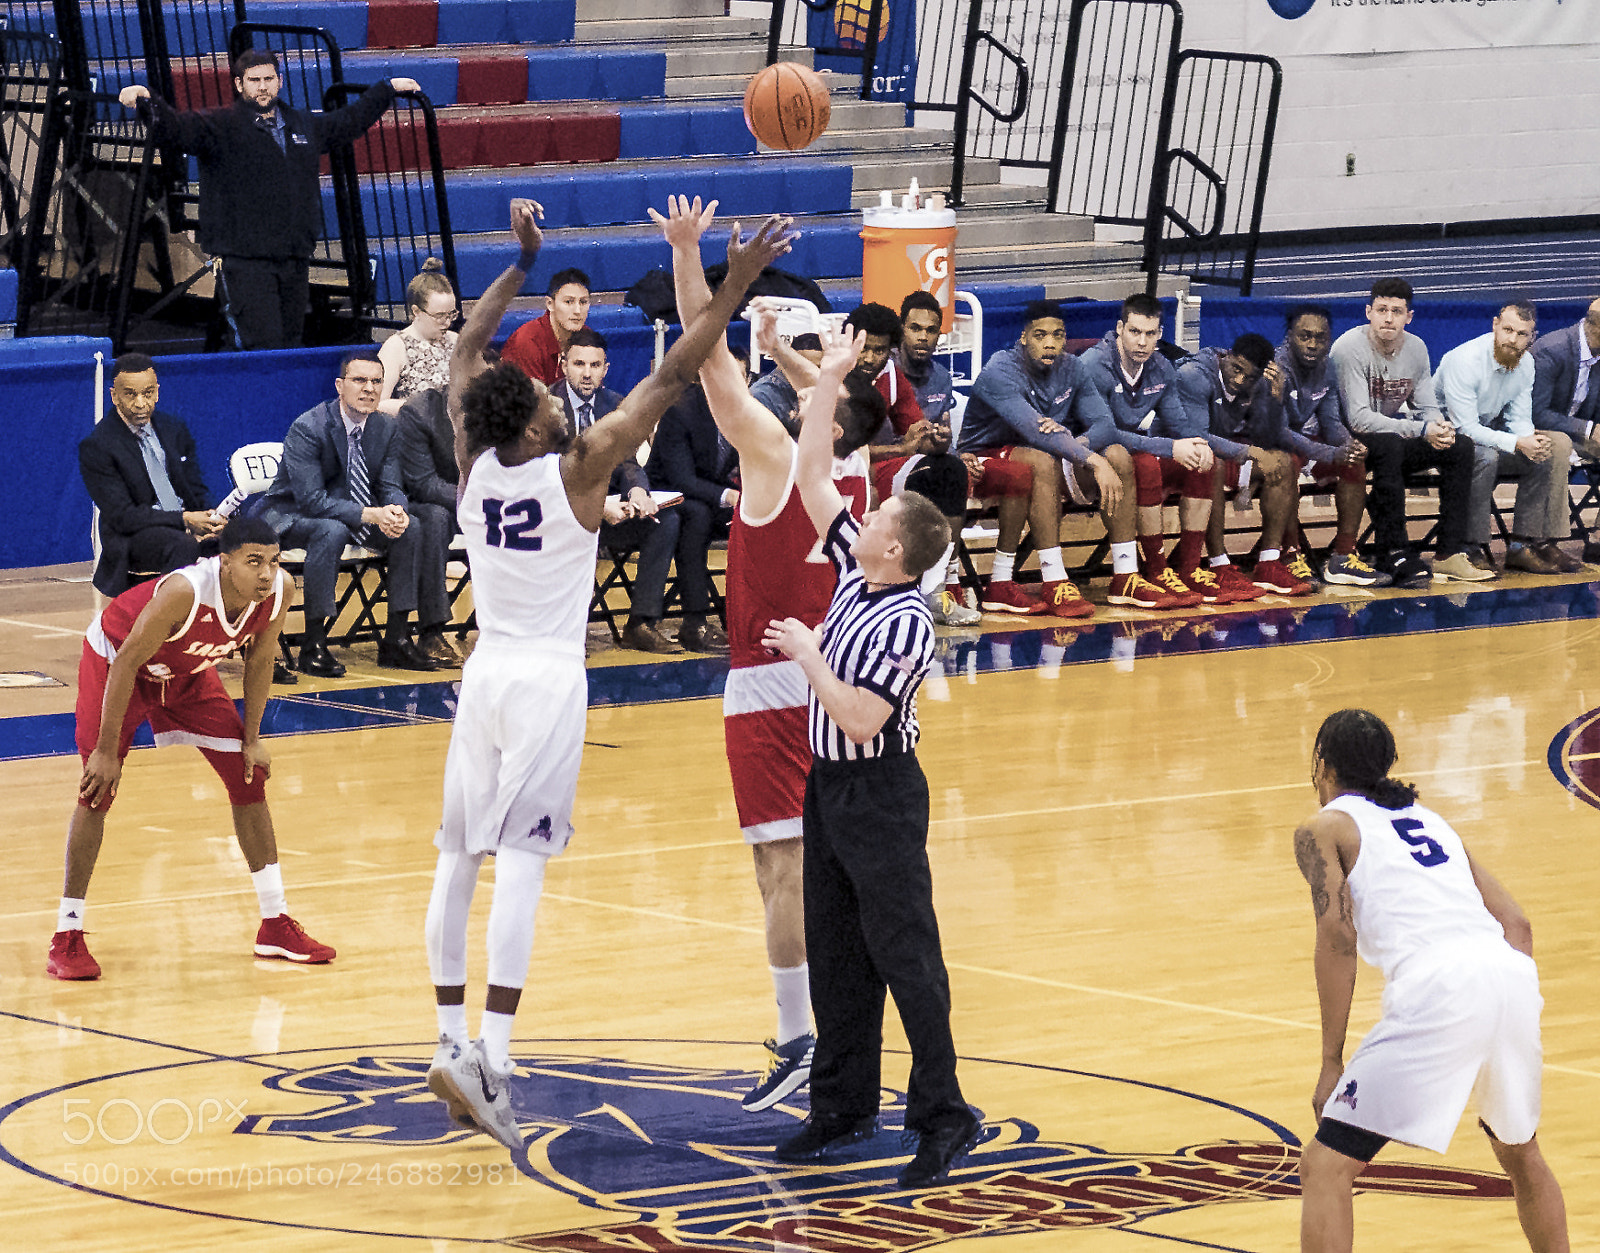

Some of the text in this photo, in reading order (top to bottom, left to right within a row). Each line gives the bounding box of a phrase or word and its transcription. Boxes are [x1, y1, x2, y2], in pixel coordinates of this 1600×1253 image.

[925, 247, 948, 279] G
[482, 498, 543, 551] 12
[1390, 817, 1450, 867] 5
